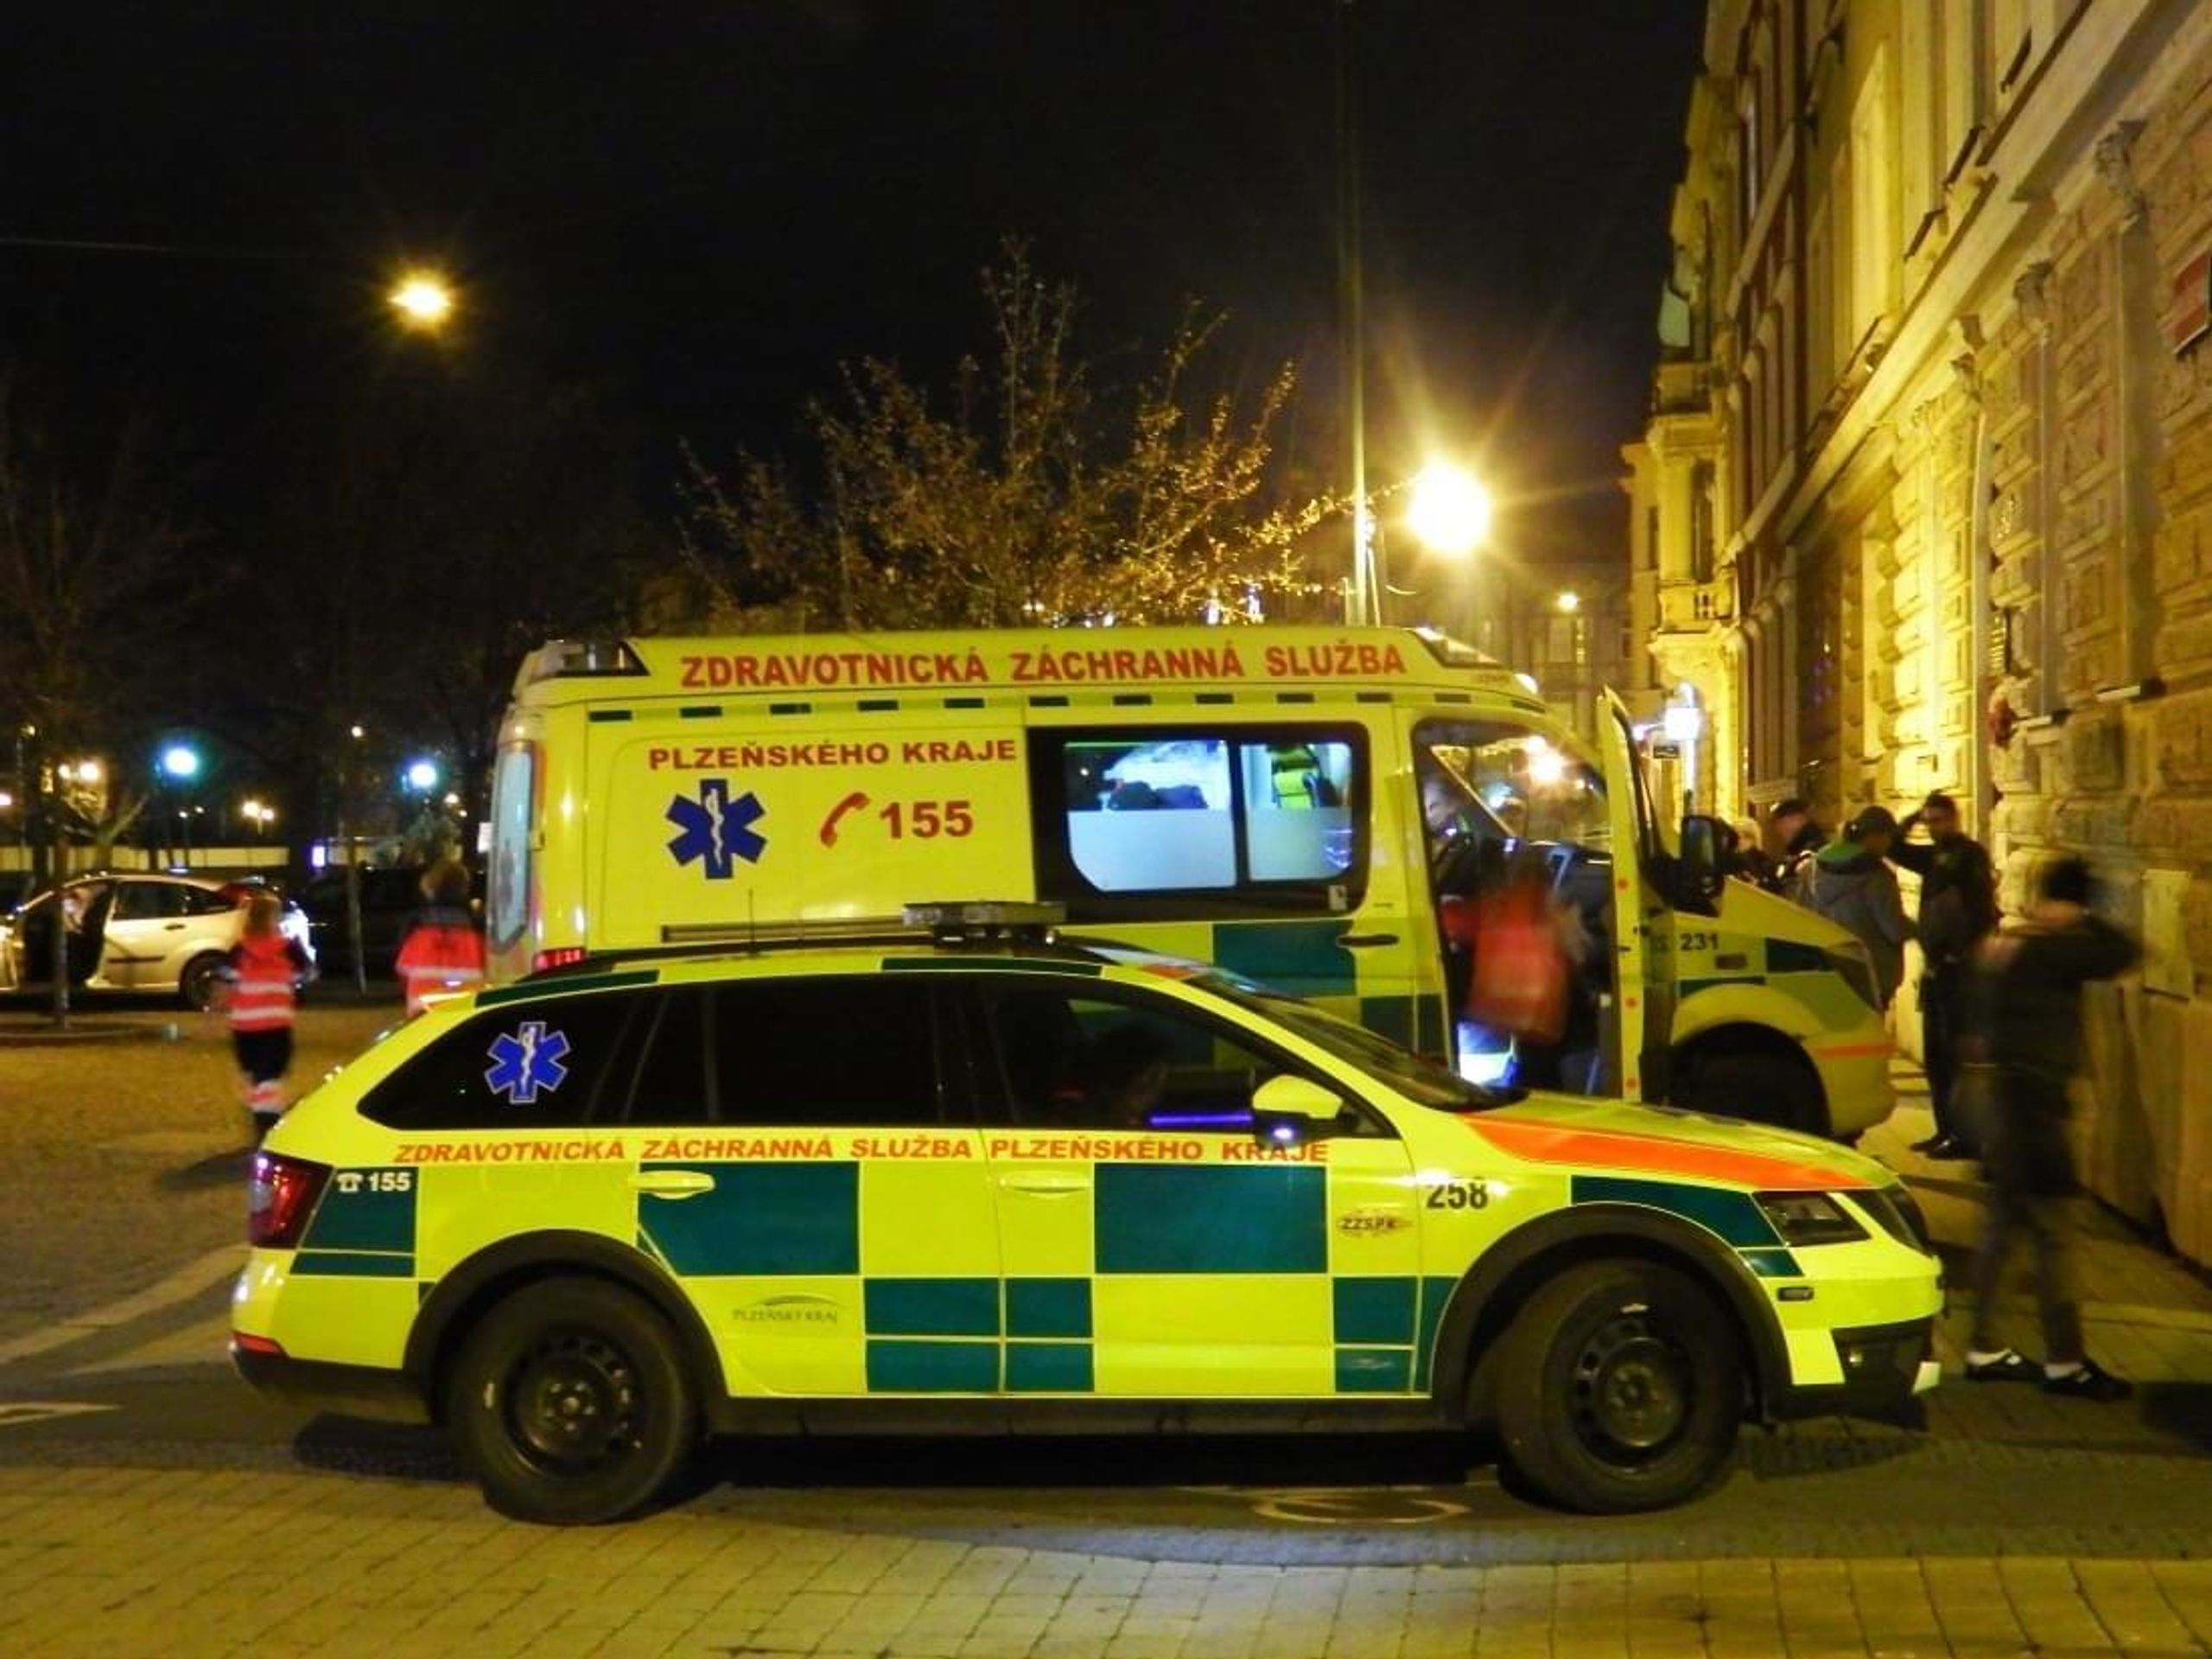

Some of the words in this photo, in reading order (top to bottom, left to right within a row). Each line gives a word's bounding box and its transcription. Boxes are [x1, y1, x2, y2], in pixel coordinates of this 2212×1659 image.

[680, 648, 989, 688] ZDRAVOTNICKÁ
[1010, 644, 1244, 683] ZÁCHRANNÁ
[1264, 639, 1407, 677] SLUŽBA
[648, 737, 891, 771] PLZEŇSKÉHO
[902, 738, 1018, 765] KRAJE
[880, 800, 974, 839] 155
[1681, 933, 1718, 950] 231
[394, 1137, 625, 1164] ZDRAVOTNICKÁ
[641, 1135, 834, 1160] ZÁCHRANNÁ
[850, 1134, 973, 1160] SLUŽBA
[990, 1135, 1204, 1161] PLZEŇSKÉHO
[1222, 1141, 1330, 1163] KRAJE
[369, 1172, 411, 1192] 155
[1427, 1176, 1488, 1210] 258
